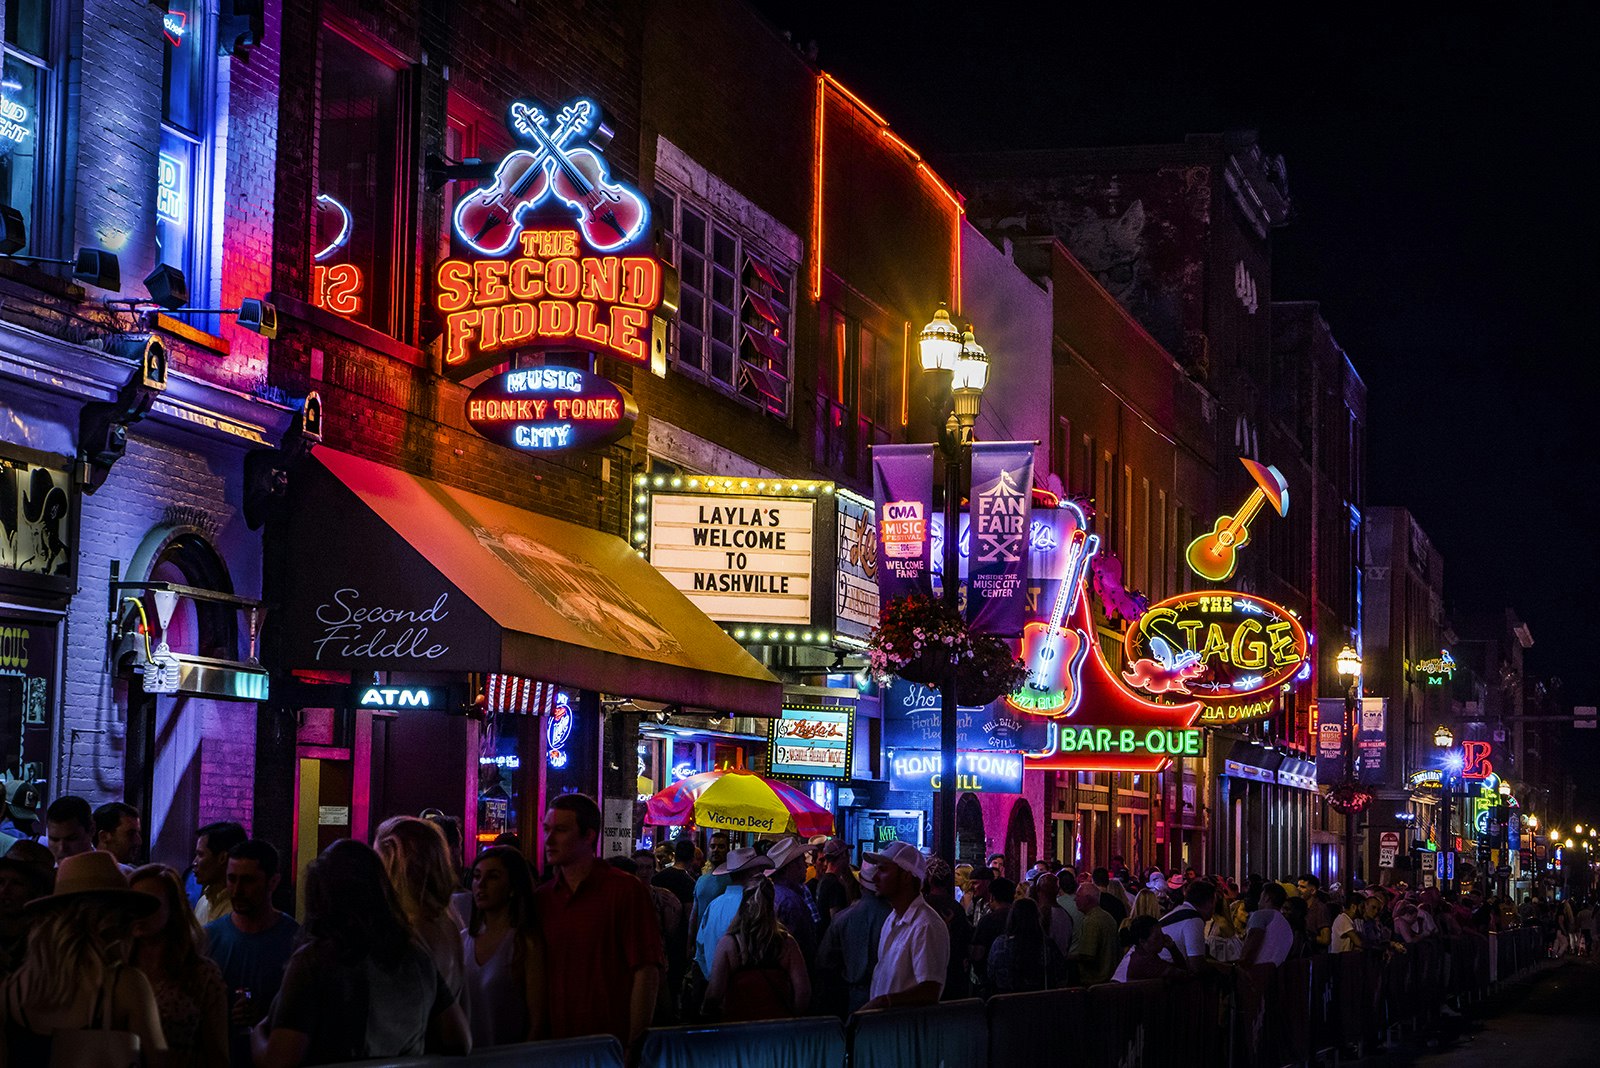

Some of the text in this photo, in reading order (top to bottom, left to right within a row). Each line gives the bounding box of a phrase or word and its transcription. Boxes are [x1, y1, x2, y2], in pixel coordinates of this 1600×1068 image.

[0, 95, 27, 122] UD
[519, 230, 580, 256] THE
[437, 256, 662, 311] SECOND
[445, 300, 648, 363] FIDDLE
[506, 368, 582, 393] MUSIC
[469, 398, 620, 421] HONKY TONK
[515, 424, 571, 447] CITY
[699, 505, 780, 527] LAYLA'S
[888, 505, 918, 520] CMA
[978, 498, 1025, 515] FAN
[885, 522, 922, 535] MUSIC
[978, 515, 1023, 533] FAIR
[693, 528, 786, 550] WELCOME
[725, 552, 747, 570] TO
[885, 561, 925, 570] WELCOME
[693, 572, 789, 593] NASHVILLE
[973, 580, 1021, 589] MUSIC CITY
[981, 588, 1013, 598] CENTER
[316, 588, 449, 625] Second
[1199, 597, 1233, 612] THE
[313, 623, 449, 661] Fiddle
[1140, 607, 1301, 670] STAGE
[360, 689, 430, 707] ATM
[988, 736, 1017, 749] GRILL
[1060, 727, 1200, 756] BAR-B-QUE
[966, 756, 1020, 779] TONK
[1461, 741, 1494, 779] B
[929, 773, 983, 790] GILL
[707, 810, 774, 832] Vienna Beef
